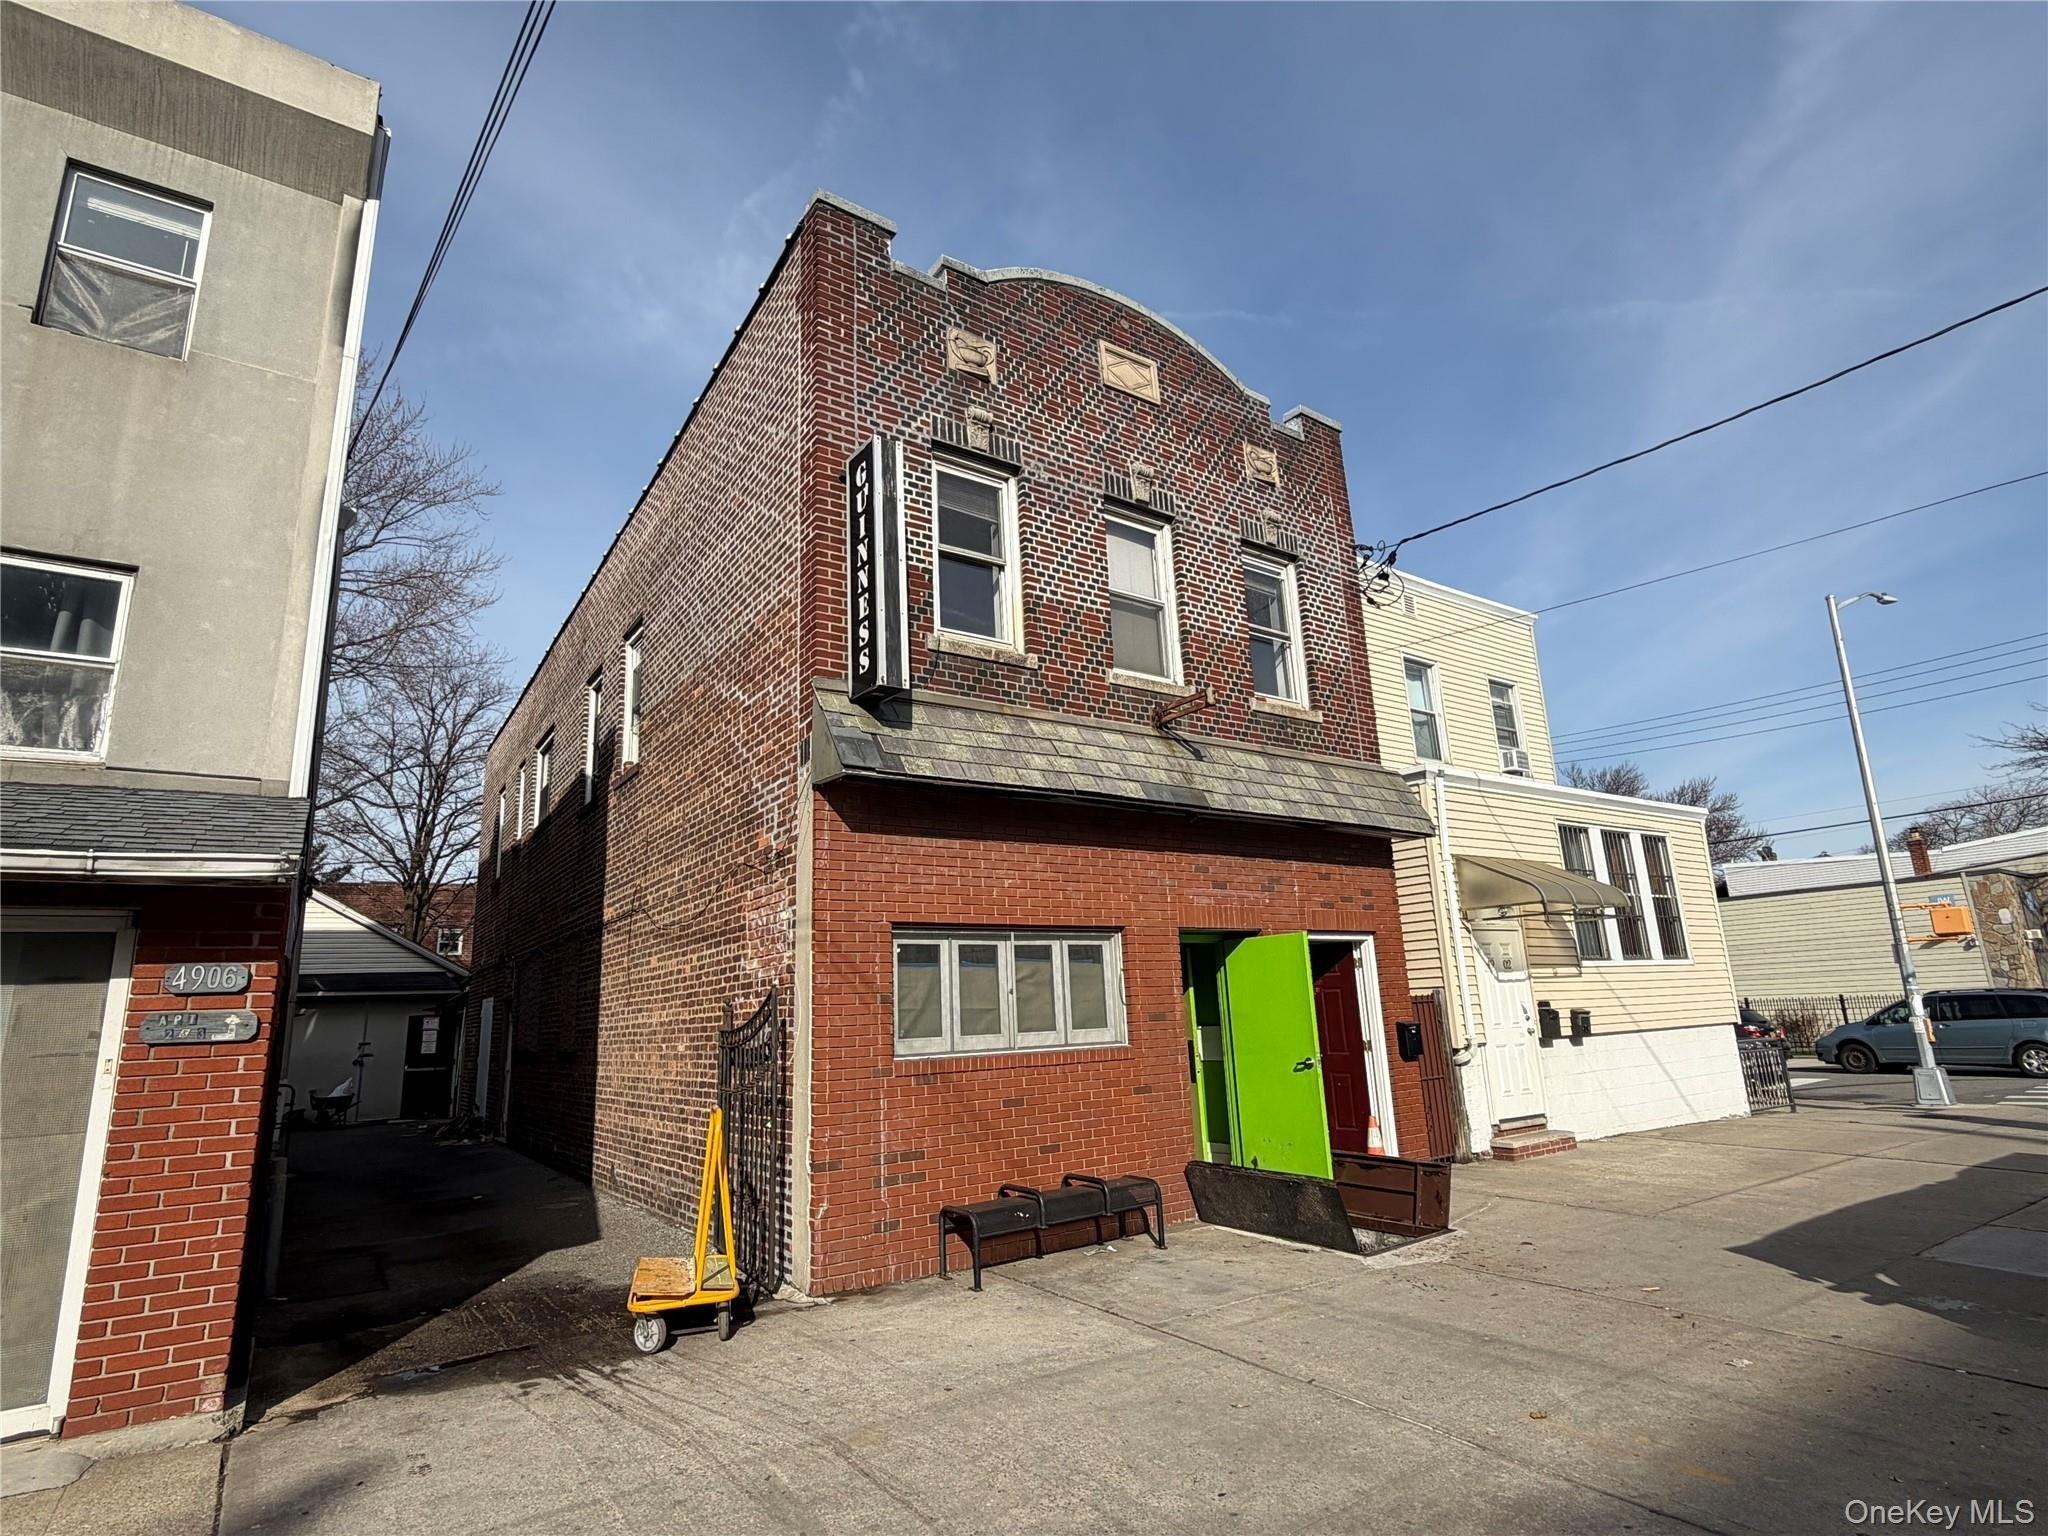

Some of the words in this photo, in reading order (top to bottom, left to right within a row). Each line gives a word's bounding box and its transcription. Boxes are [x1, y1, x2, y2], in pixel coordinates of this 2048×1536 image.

[855, 460, 870, 675] GUINNESS
[172, 965, 237, 991] 4906
[159, 1014, 197, 1026] APT
[165, 1030, 173, 1039] 2
